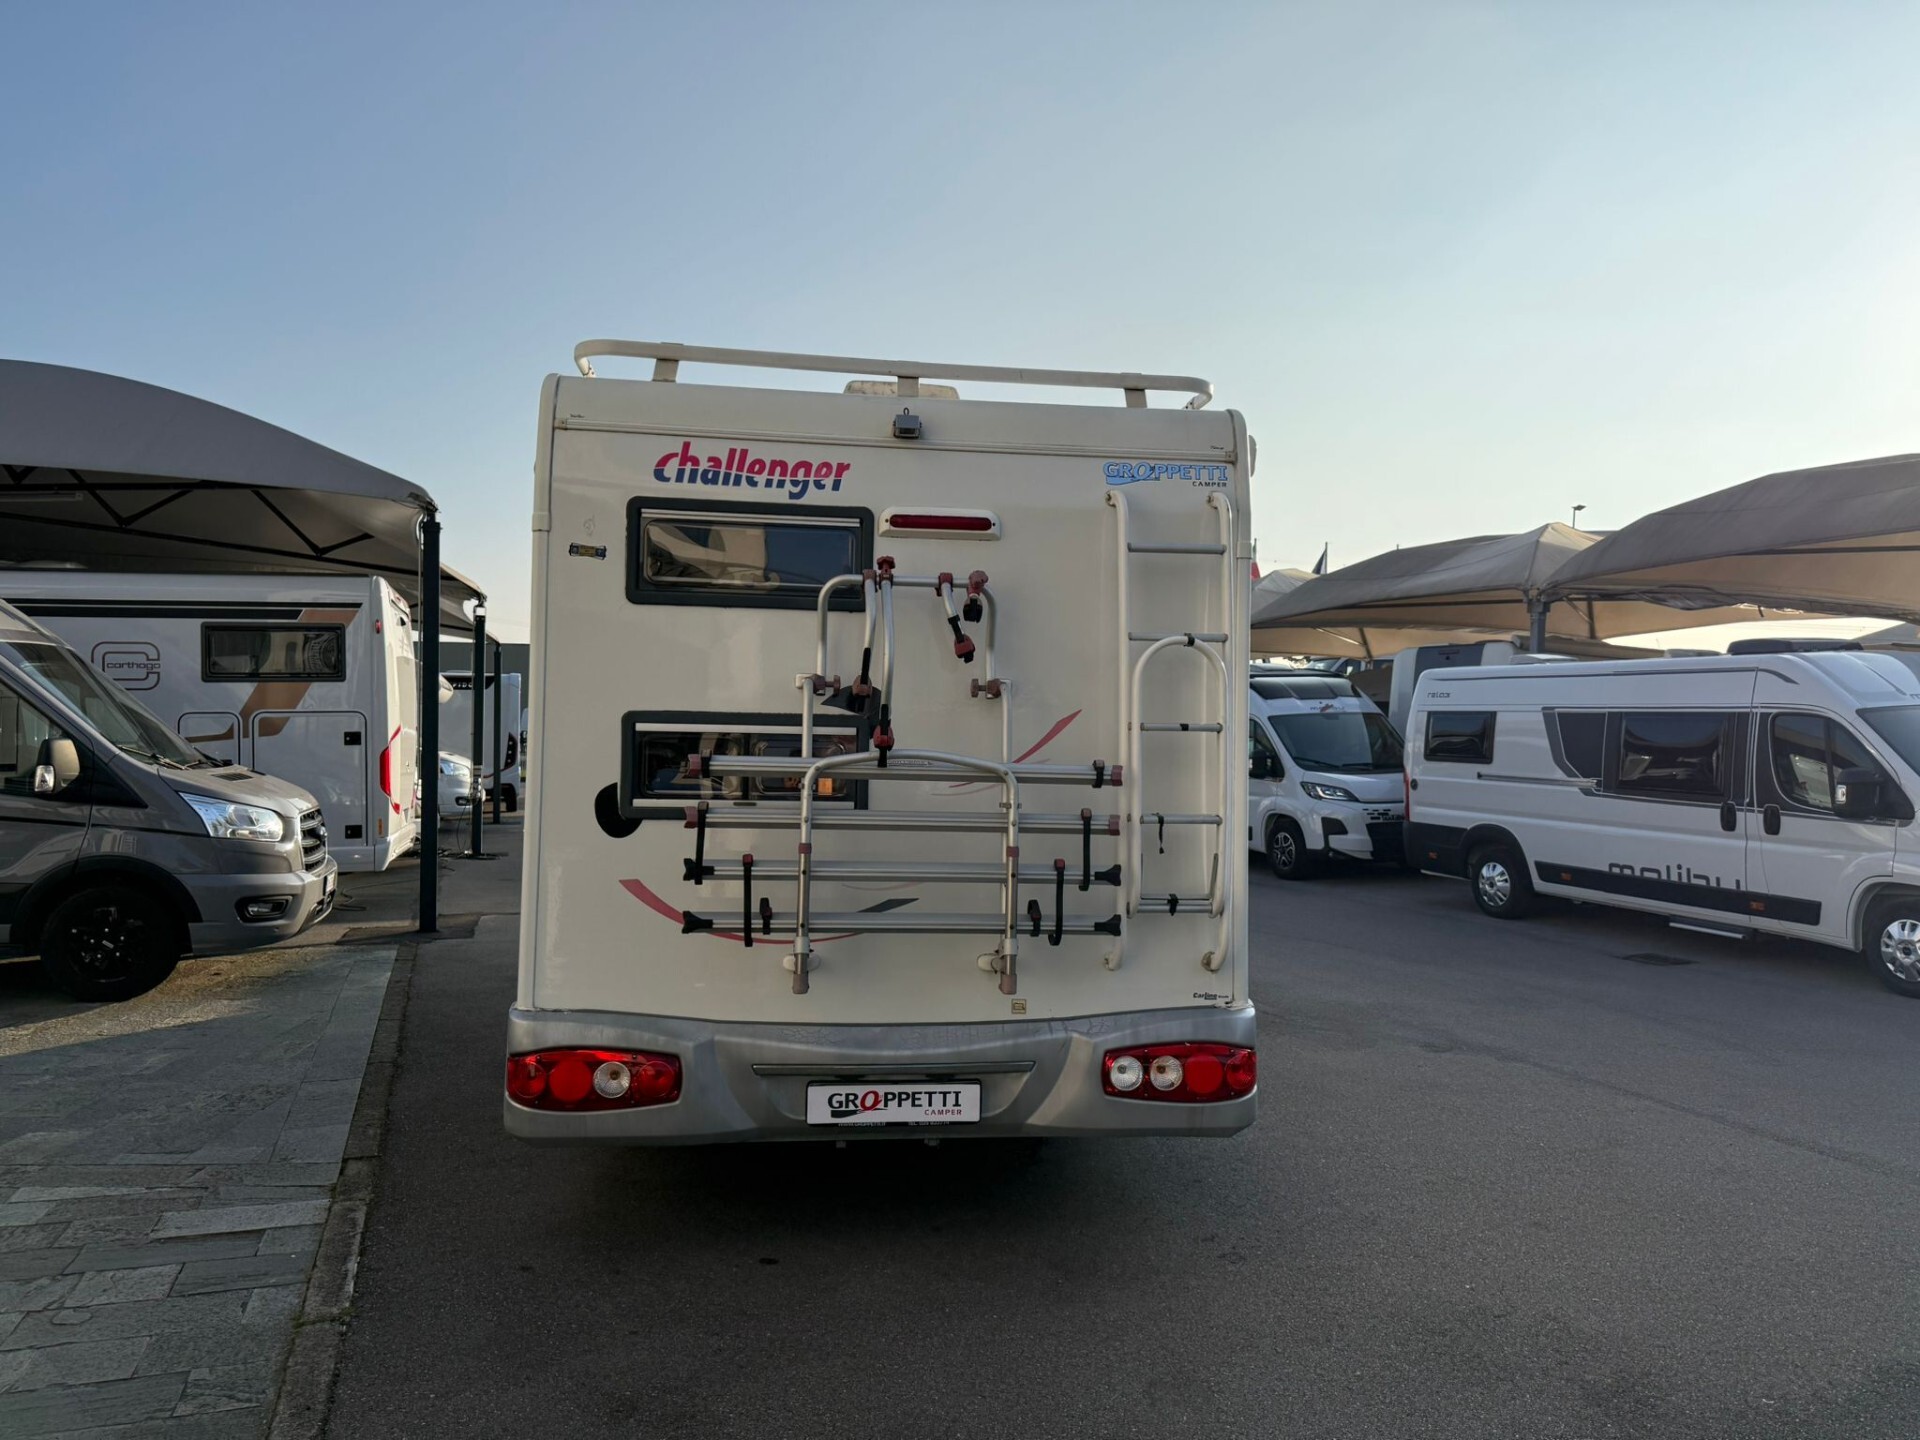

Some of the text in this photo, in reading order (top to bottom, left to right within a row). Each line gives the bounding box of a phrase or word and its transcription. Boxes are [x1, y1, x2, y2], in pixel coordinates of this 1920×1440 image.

[653, 441, 851, 500] challenger
[1103, 461, 1228, 482] GROPPETTI
[106, 661, 161, 671] carthago
[828, 1090, 962, 1111] GROPPETTI
